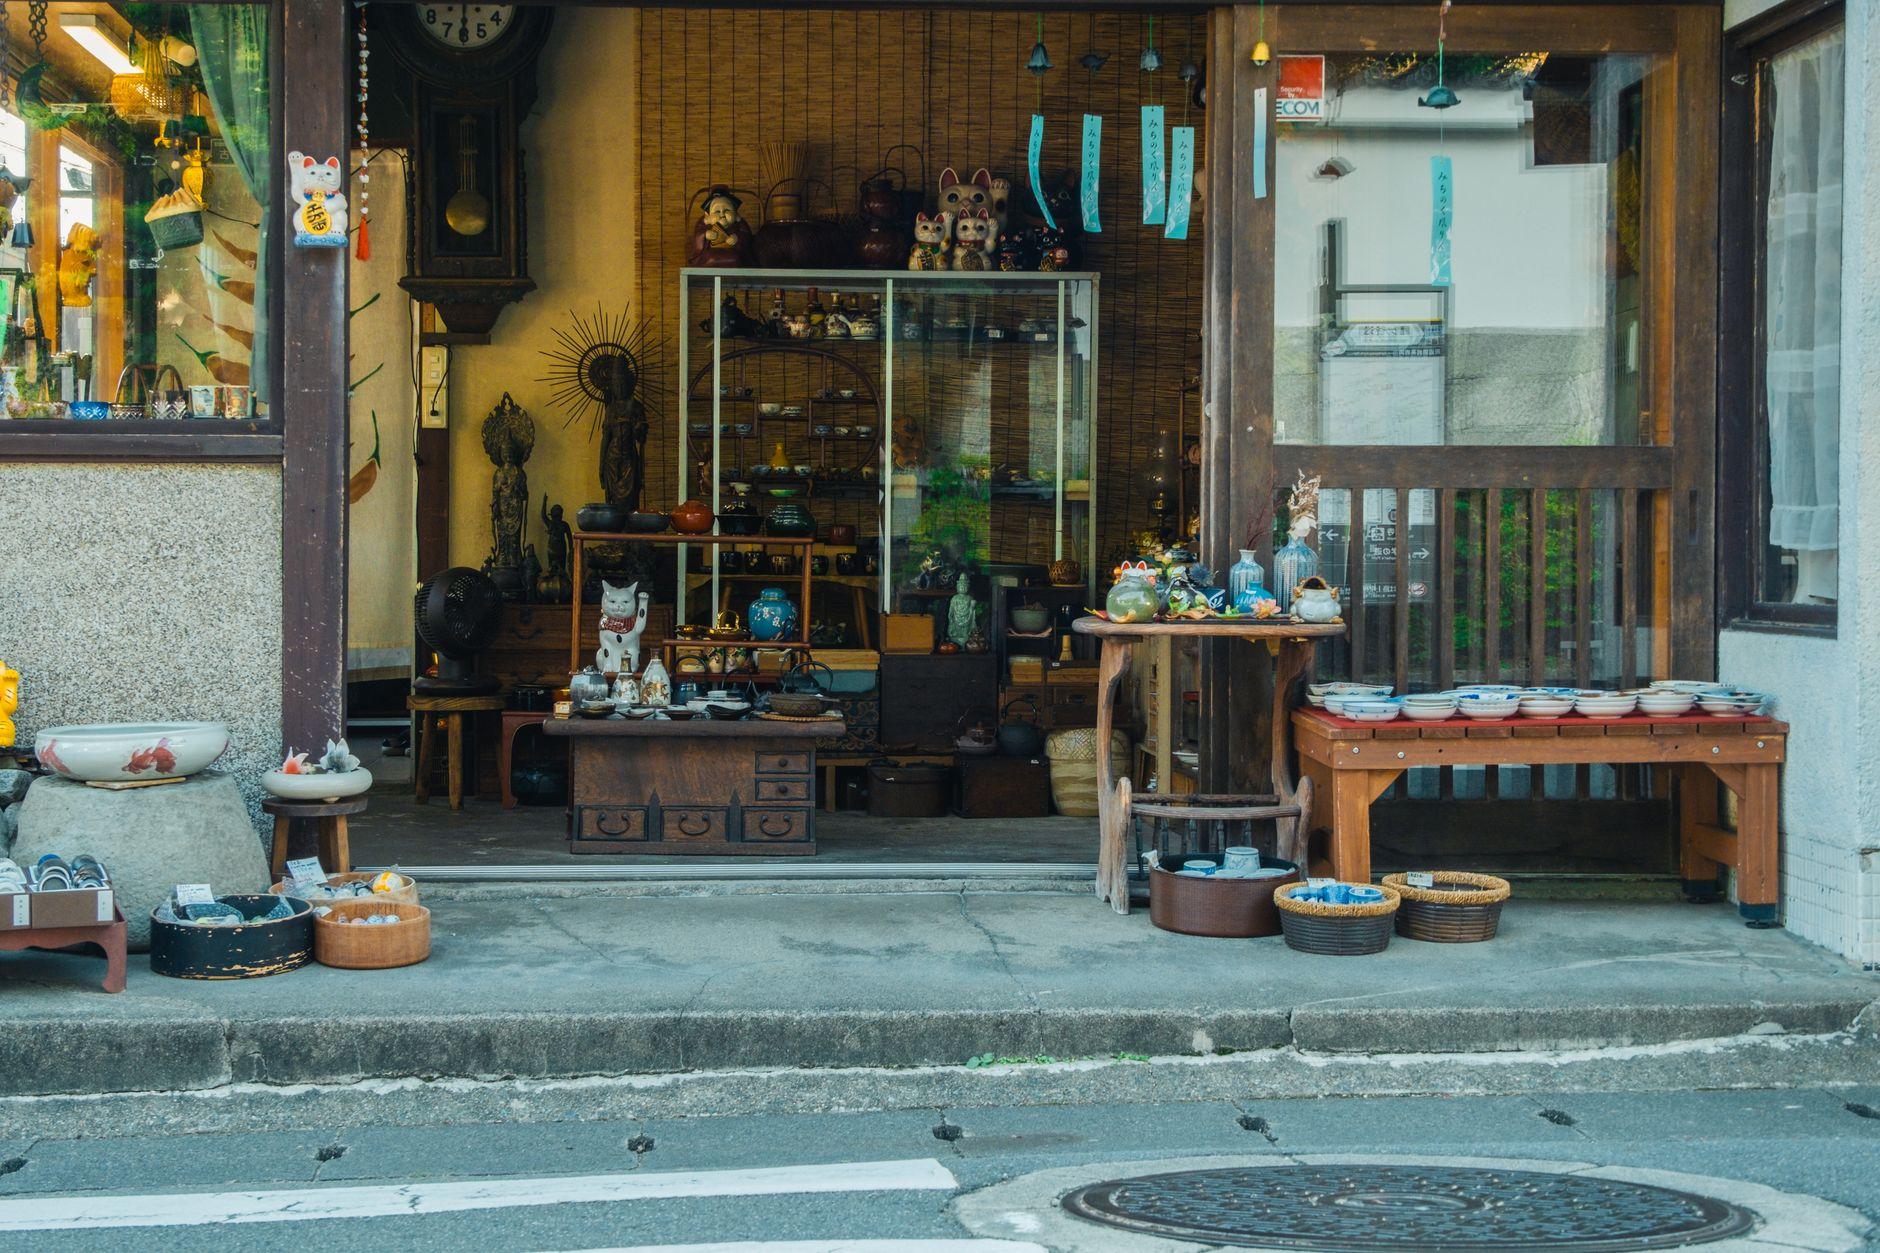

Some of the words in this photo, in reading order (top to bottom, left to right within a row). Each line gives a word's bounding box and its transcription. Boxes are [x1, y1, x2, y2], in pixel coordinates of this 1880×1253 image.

[426, 9, 437, 24] 8
[490, 10, 502, 26] 4
[442, 22, 453, 38] 7
[476, 23, 487, 39] 5
